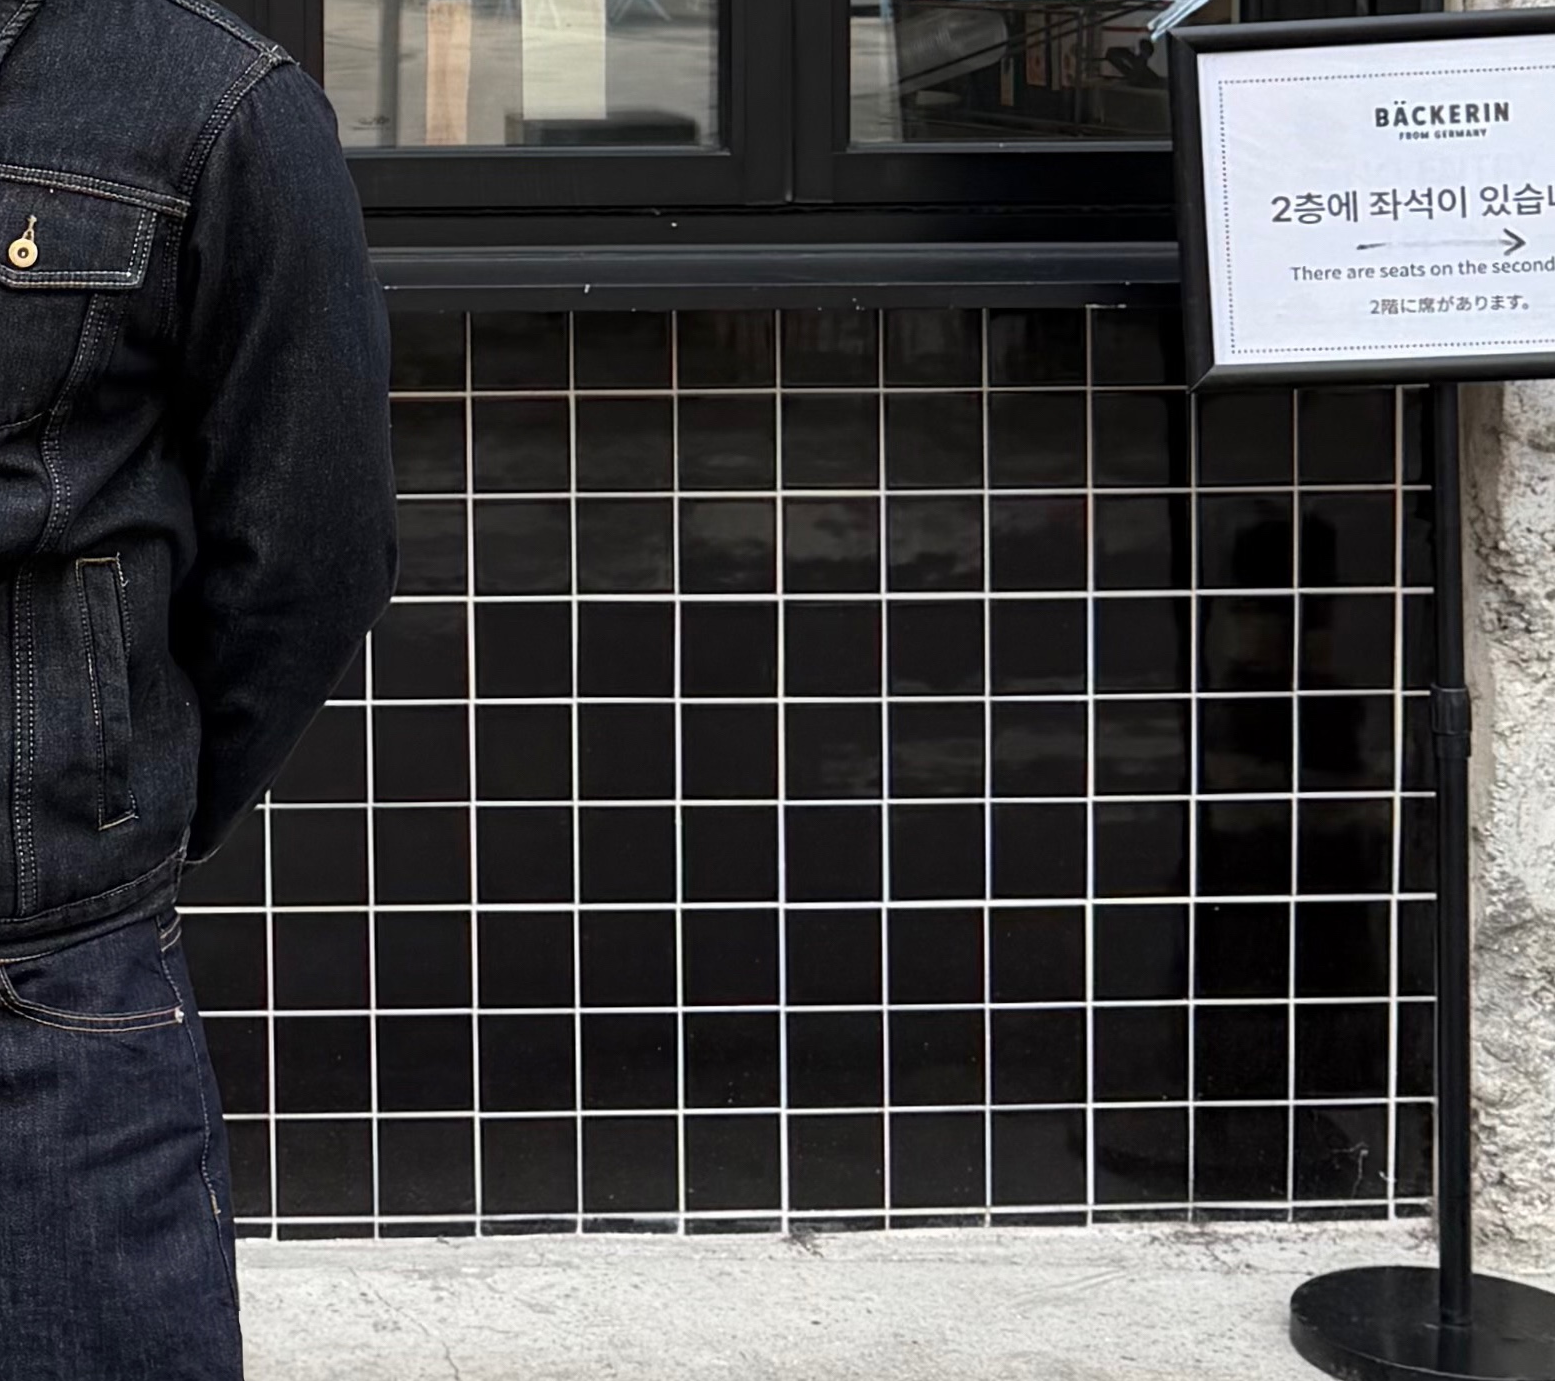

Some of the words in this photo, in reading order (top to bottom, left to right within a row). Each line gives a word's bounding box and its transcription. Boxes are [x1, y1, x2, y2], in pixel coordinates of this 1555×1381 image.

[1375, 100, 1509, 128] BÄCKERIN
[1399, 131, 1429, 140] FROM
[1434, 128, 1487, 139] GERMANY
[1271, 190, 1359, 224] 2층에
[1369, 185, 1467, 221] 좌석이
[1290, 266, 1342, 281] There
[1346, 266, 1375, 279] are
[1380, 263, 1426, 278] seats
[1430, 264, 1453, 276] on
[1458, 259, 1487, 275] the
[1492, 256, 1555, 274] second
[1369, 295, 1530, 315] 2階に席があります。
